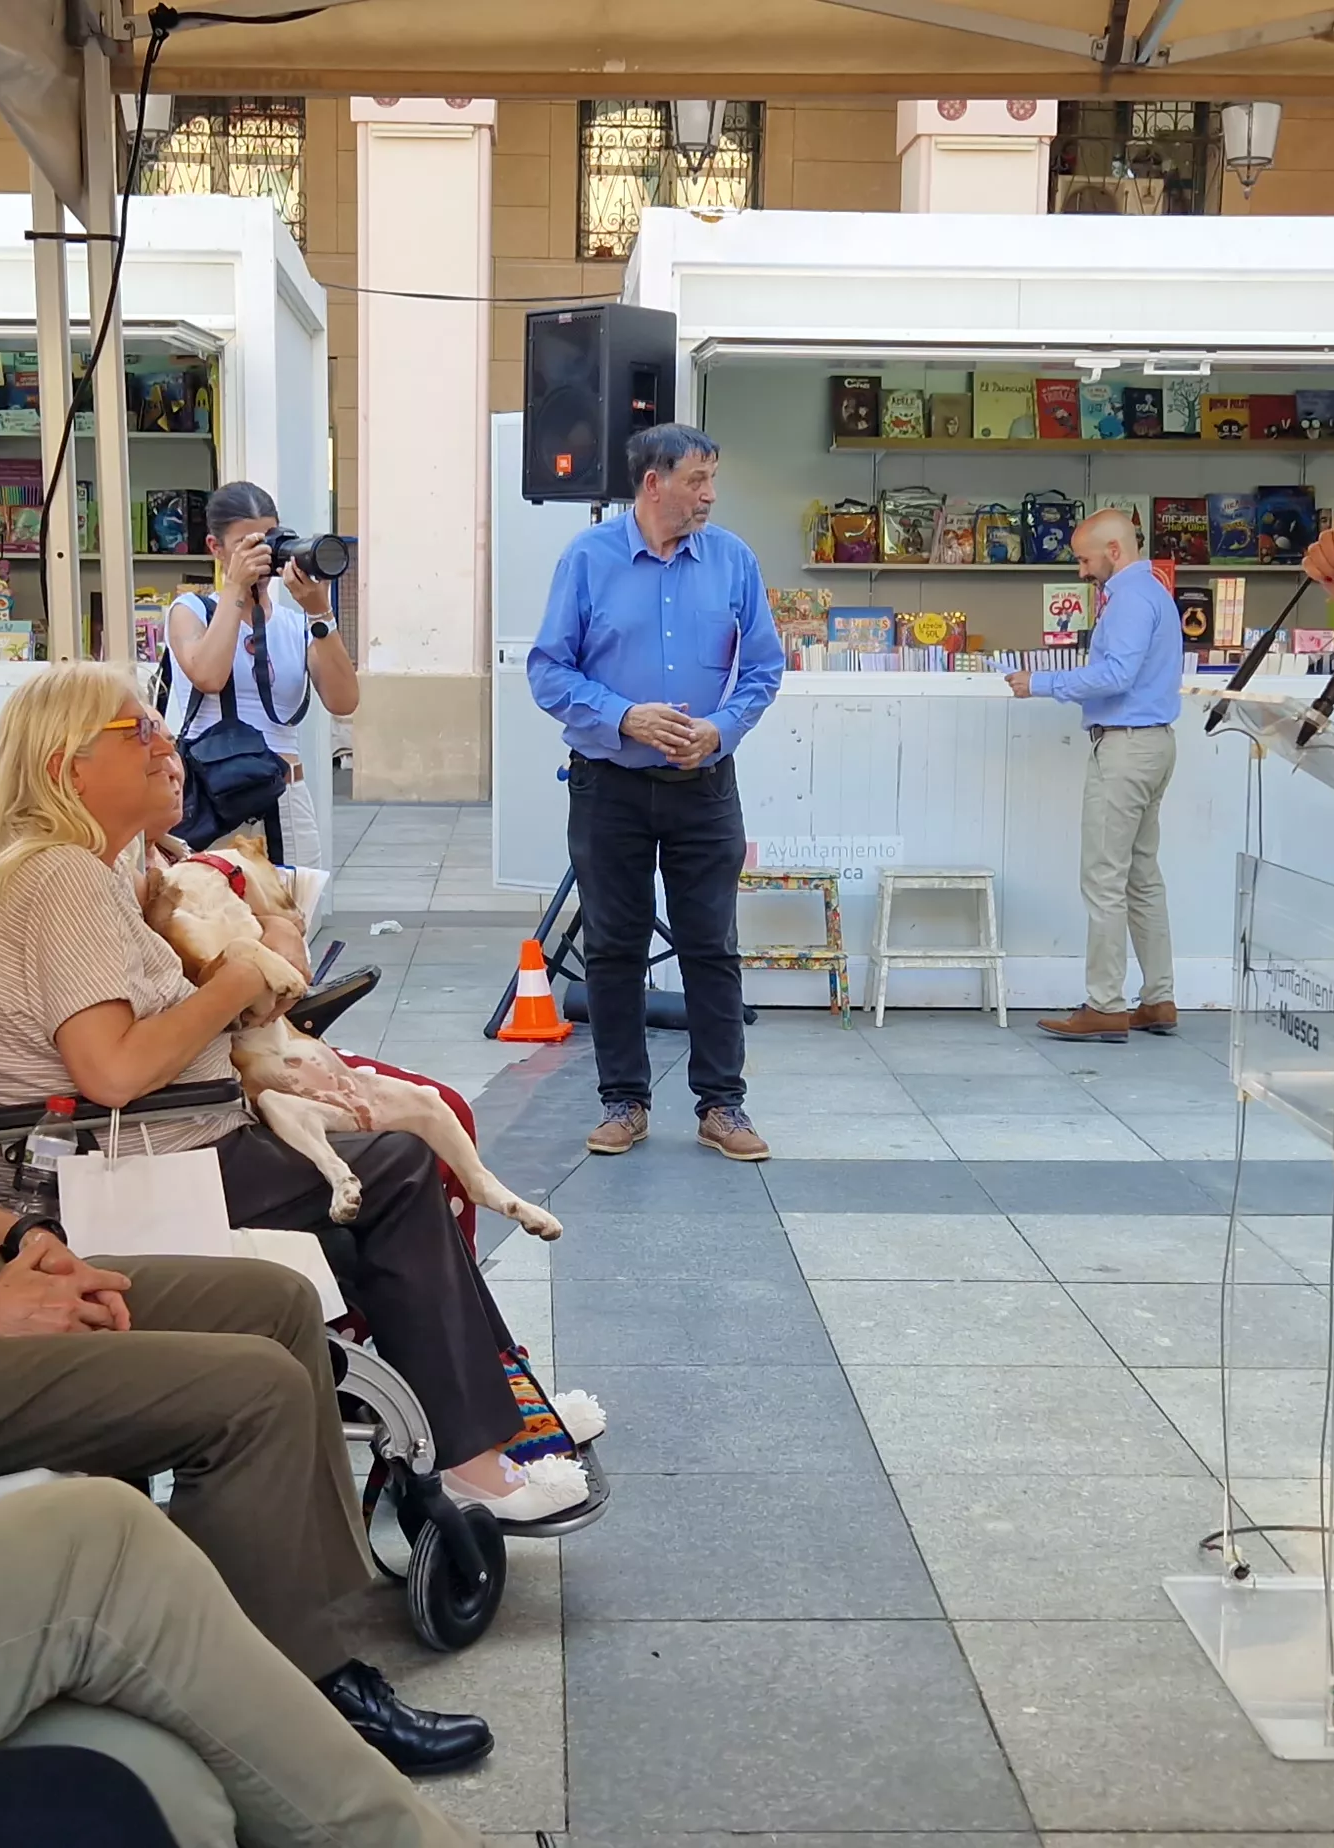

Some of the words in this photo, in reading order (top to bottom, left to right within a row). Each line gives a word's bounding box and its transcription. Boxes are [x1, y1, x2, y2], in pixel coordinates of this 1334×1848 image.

[1049, 598, 1083, 617] GOA
[765, 841, 897, 859] Ayuntamiento
[1279, 1000, 1319, 1052] Huesca
